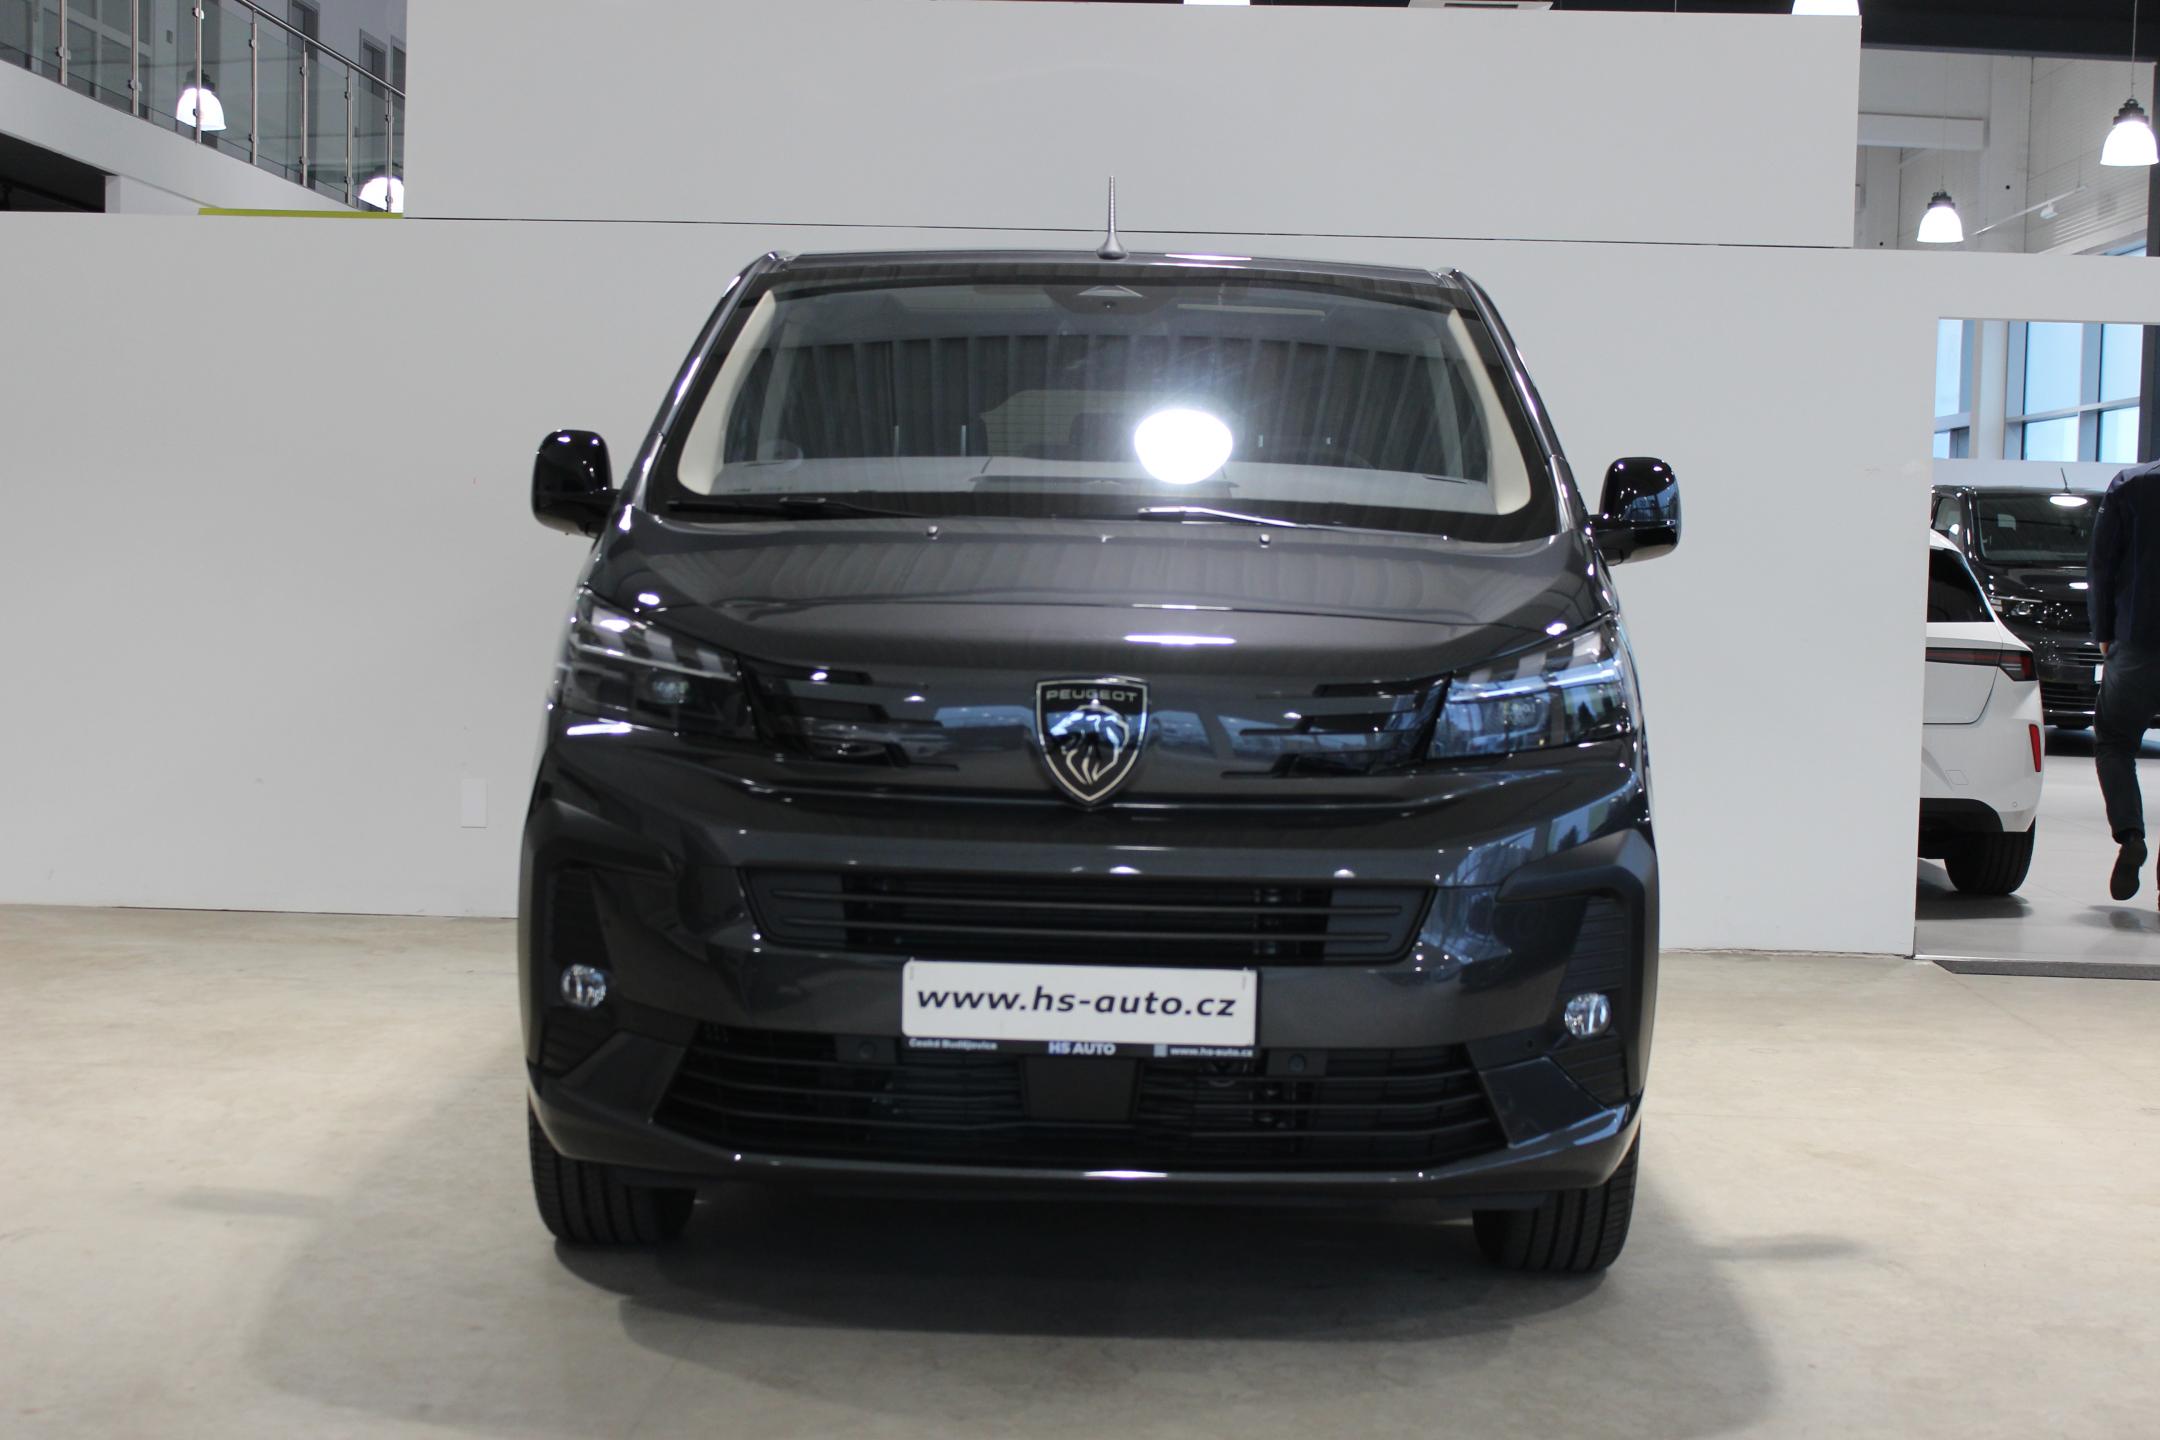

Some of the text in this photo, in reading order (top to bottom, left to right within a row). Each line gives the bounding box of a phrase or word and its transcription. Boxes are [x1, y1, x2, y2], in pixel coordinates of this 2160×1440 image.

[1046, 688, 1137, 702] PEUGEOT
[917, 986, 1236, 1016] www.hs-auto.cz
[1048, 1041, 1116, 1056] HS AUTO
[1170, 1047, 1253, 1057] www.hs-auto.cz
